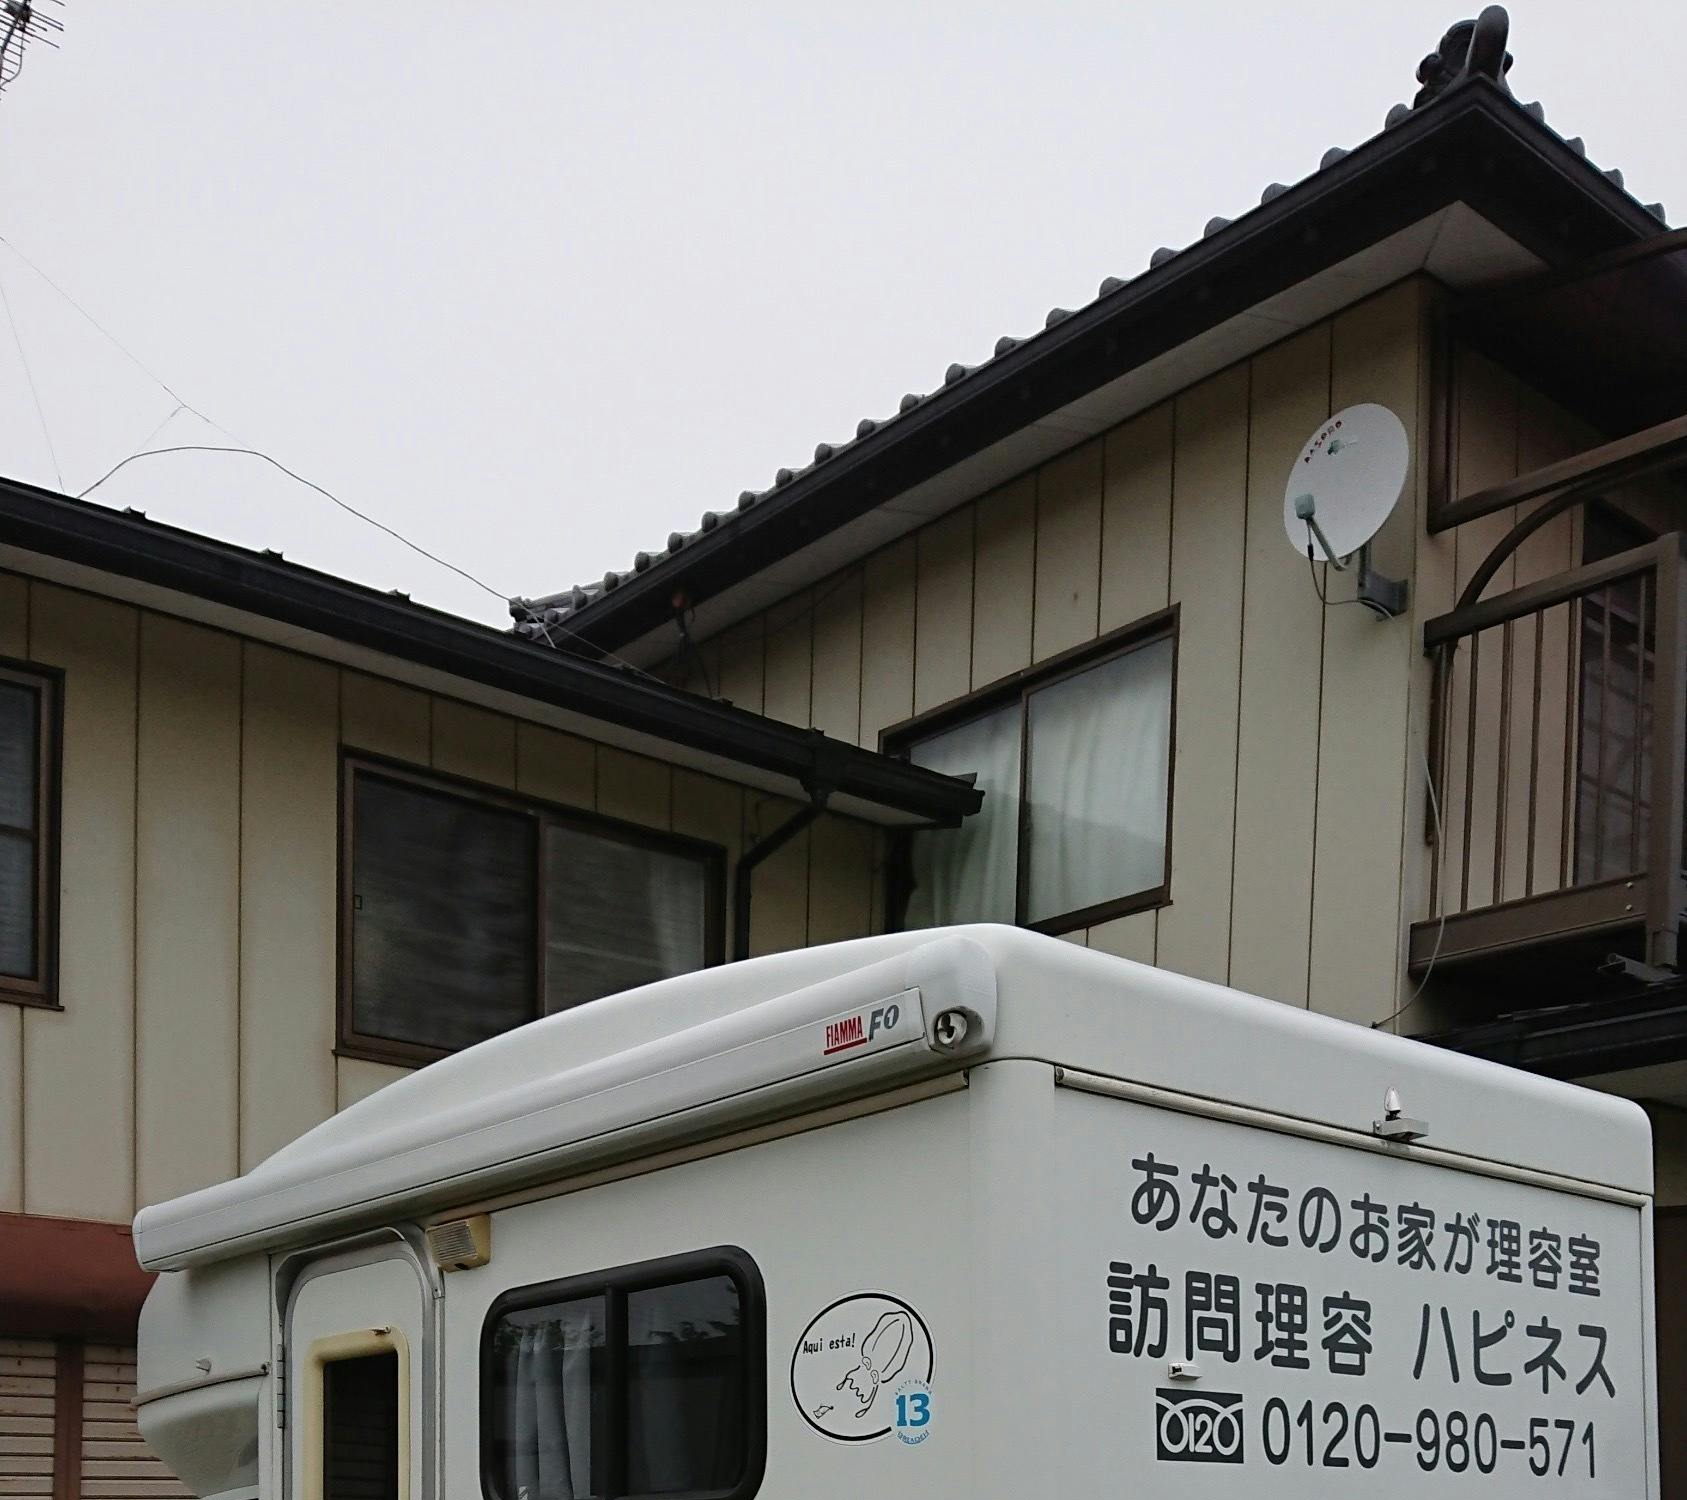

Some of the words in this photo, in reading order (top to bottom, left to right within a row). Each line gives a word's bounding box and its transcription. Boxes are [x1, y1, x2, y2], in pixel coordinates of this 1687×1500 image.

[825, 1015, 864, 1049] FIAMMA
[1131, 1151, 1601, 1298] あなたのお家が理容室
[802, 1338, 823, 1355] Aqui
[1107, 1261, 1372, 1376] 訪問理容
[1412, 1302, 1616, 1399] ハピネス
[895, 1393, 931, 1427] 13
[1262, 1396, 1596, 1480] 0120-980-571
